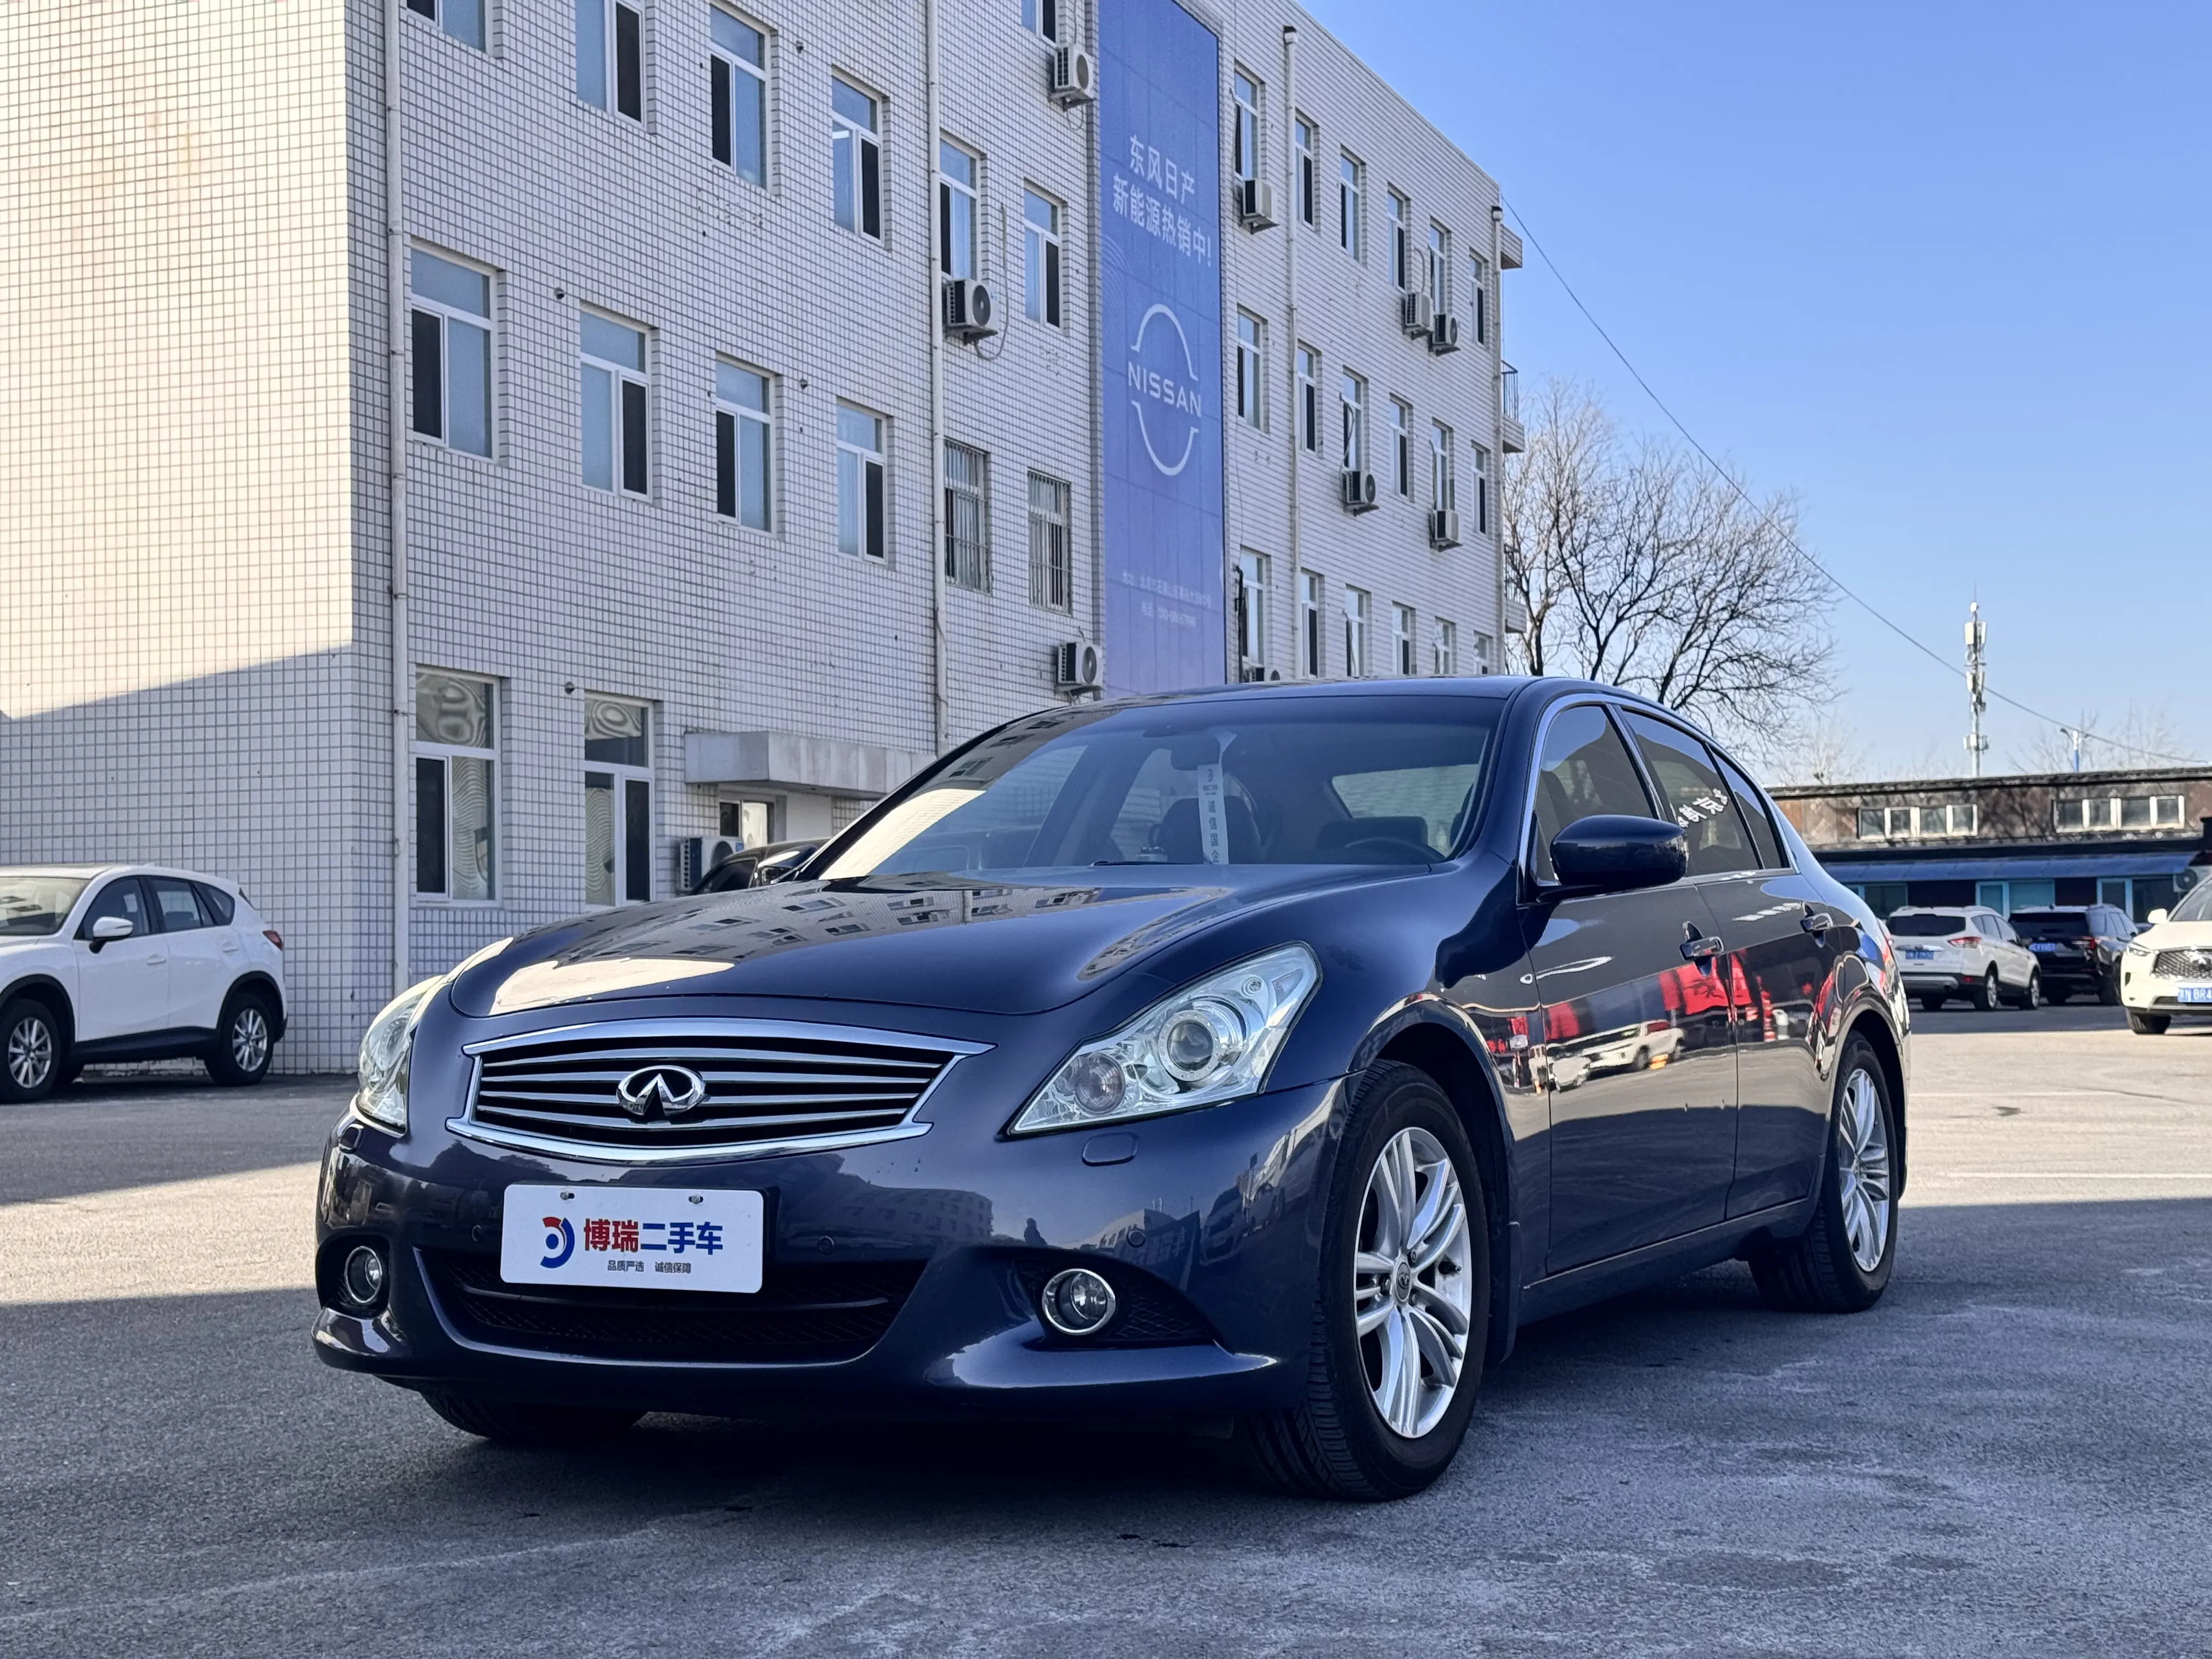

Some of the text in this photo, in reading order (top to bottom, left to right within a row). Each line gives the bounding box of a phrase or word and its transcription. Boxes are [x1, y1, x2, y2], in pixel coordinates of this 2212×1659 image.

[1130, 134, 1195, 205] 东风日产
[1113, 172, 1211, 267] 新能源热销中！
[1128, 361, 1201, 417] NISSAN
[584, 1218, 724, 1255] 博瑞二手车
[607, 1260, 692, 1274] 品质严选 诚信保障
